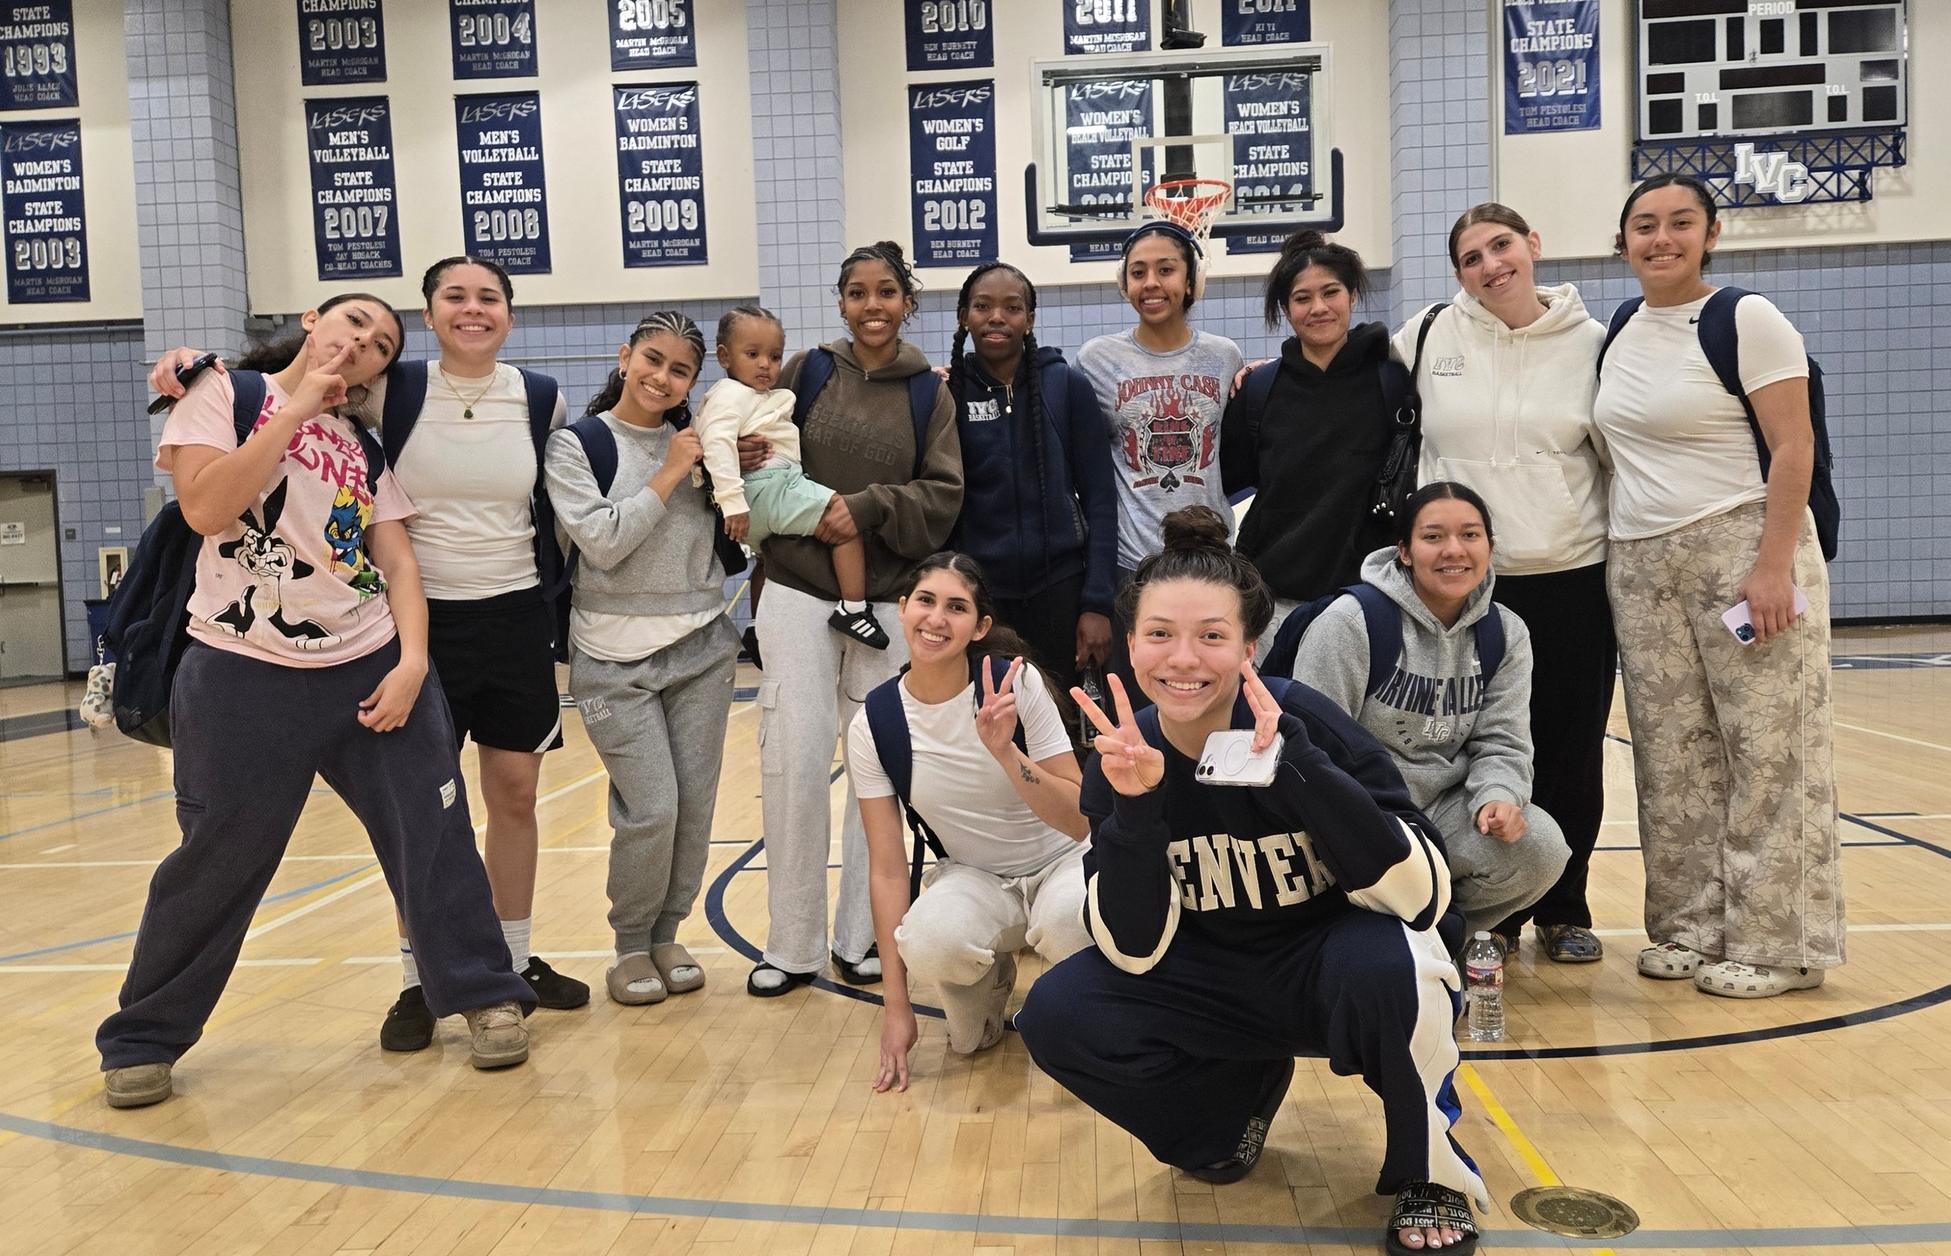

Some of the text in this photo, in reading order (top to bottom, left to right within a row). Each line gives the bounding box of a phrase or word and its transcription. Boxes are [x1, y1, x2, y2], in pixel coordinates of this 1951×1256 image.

[13, 6, 50, 20] STATE
[302, 0, 377, 13] CHAMPIONS
[1076, 0, 1137, 25] 2011
[1748, 1, 1796, 16] PERIOD
[618, 0, 686, 31] 2005
[921, 0, 986, 33] 2010
[0, 22, 69, 39] CHAMPIONS
[309, 16, 377, 50] 2003
[458, 12, 532, 46] 2004
[1527, 19, 1575, 36] STATE
[616, 38, 647, 48] MARTIN
[1069, 34, 1103, 45] MARTIN
[1241, 32, 1290, 43] HEAD COACH
[1511, 33, 1593, 53] CHAMPIONS
[629, 46, 677, 57] HEAD COACH
[927, 51, 975, 61] HEAD COACH
[1083, 42, 1133, 54] HEAD COACH
[5, 42, 67, 77] 1993
[308, 59, 338, 68] MARTIN
[459, 53, 489, 62] MARTIN
[321, 67, 367, 77] HEAD COACH
[472, 61, 519, 71] HEAD COACH
[1228, 72, 1309, 92] LASERS
[1518, 59, 1588, 98] 2021
[15, 92, 60, 102] HEAD COACH
[913, 86, 991, 109] LASERS
[1070, 79, 1150, 100] LASERS
[1237, 101, 1300, 117] WOMEN'S
[1520, 106, 1538, 117] TOM
[1080, 109, 1142, 126] WOMEN'S
[1527, 115, 1580, 127] HEAD COACH
[922, 118, 984, 134] WOMEN'S
[1100, 126, 1150, 142] VOLLEYBALL
[1228, 118, 1309, 135] BEACH VOLLEYBALL
[328, 131, 369, 146] MEN'S
[478, 130, 520, 146] MEN'S
[619, 134, 697, 151] BADMINTON
[936, 136, 971, 151] GOLF
[313, 146, 390, 163] VOLLEYBALL
[462, 147, 539, 163] VOLLEYBALL
[1249, 145, 1290, 160] STATE
[13, 159, 71, 176] WOMEN'S
[641, 159, 682, 174] STATE
[933, 161, 974, 176] STATE
[1091, 153, 1132, 169] STATE
[1234, 162, 1309, 178] CHAMPIONS
[1734, 142, 1809, 204] IVC
[6, 176, 80, 194] BADMINTON
[334, 171, 373, 186] STATE
[483, 171, 523, 186] STATE
[625, 176, 700, 192] CHAMPIONS
[916, 177, 992, 194] CHAMPIONS
[1073, 170, 1150, 188] CHAMPIOS
[318, 188, 392, 204] CHAMPIONS
[466, 189, 542, 205] CHAMPIONS
[25, 201, 63, 216] STATE
[627, 199, 699, 233] 2009
[924, 199, 986, 231] 2012
[9, 218, 81, 234] CHAMPIONS
[324, 205, 388, 239] 2007
[474, 208, 540, 242] 2008
[328, 243, 344, 252] TOM
[629, 239, 659, 249] MARTIN
[1089, 243, 1110, 252] HEAD
[1247, 234, 1291, 245] HEAD COAC
[15, 237, 81, 270] 2003
[478, 249, 494, 257] TOM
[641, 247, 689, 258] HEAD COACH
[933, 249, 980, 259] HEAD COACH
[360, 260, 393, 270] COACHES
[508, 256, 531, 266] COACH
[14, 277, 43, 286] MARTIN
[26, 286, 72, 296] HEAD COACH
[1432, 355, 1465, 371] IVC
[1115, 374, 1221, 411] JOHNNY CASH
[968, 399, 998, 415] IVC
[1166, 830, 1337, 912] ENVER
